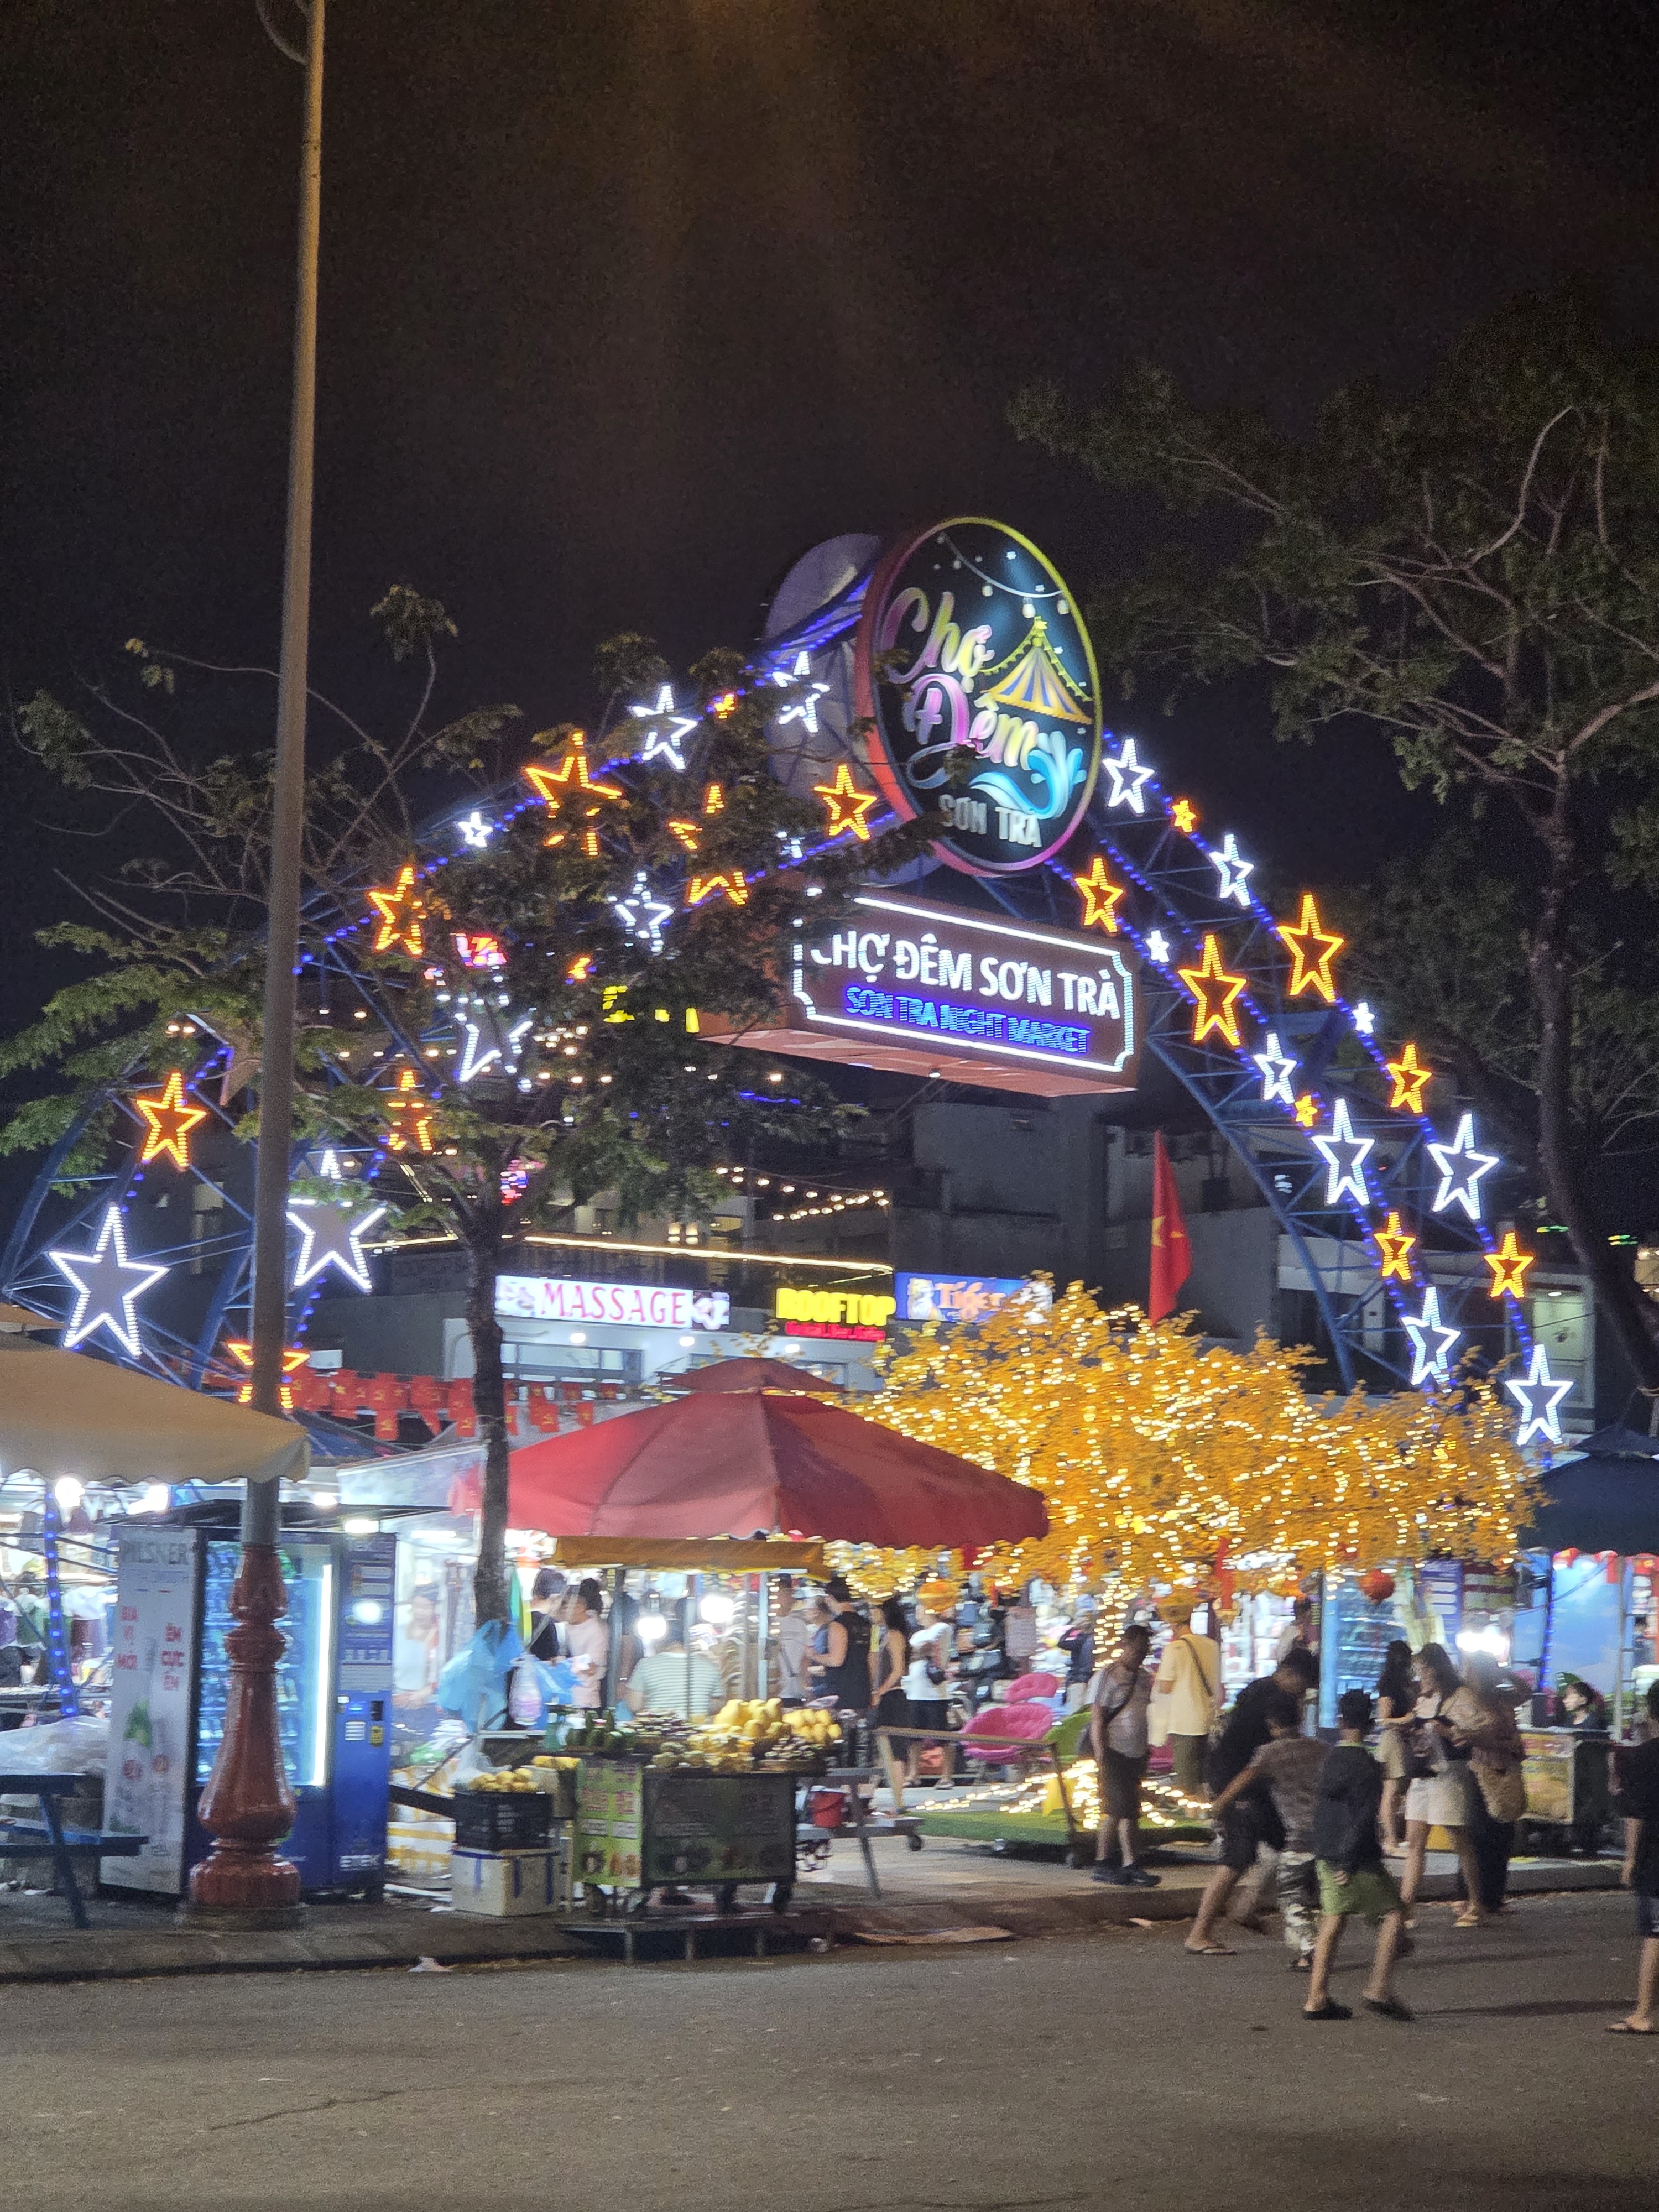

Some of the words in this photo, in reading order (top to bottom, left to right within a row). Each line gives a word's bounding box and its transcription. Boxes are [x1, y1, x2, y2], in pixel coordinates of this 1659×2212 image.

[893, 933, 972, 991] ĐÊM
[979, 957, 1052, 1006] SƠN
[1057, 969, 1121, 1020] TRÀ
[1008, 1016, 1091, 1053] MARKET
[540, 1282, 687, 1325] MASSAGE
[776, 1287, 896, 1326] ROOFTOP
